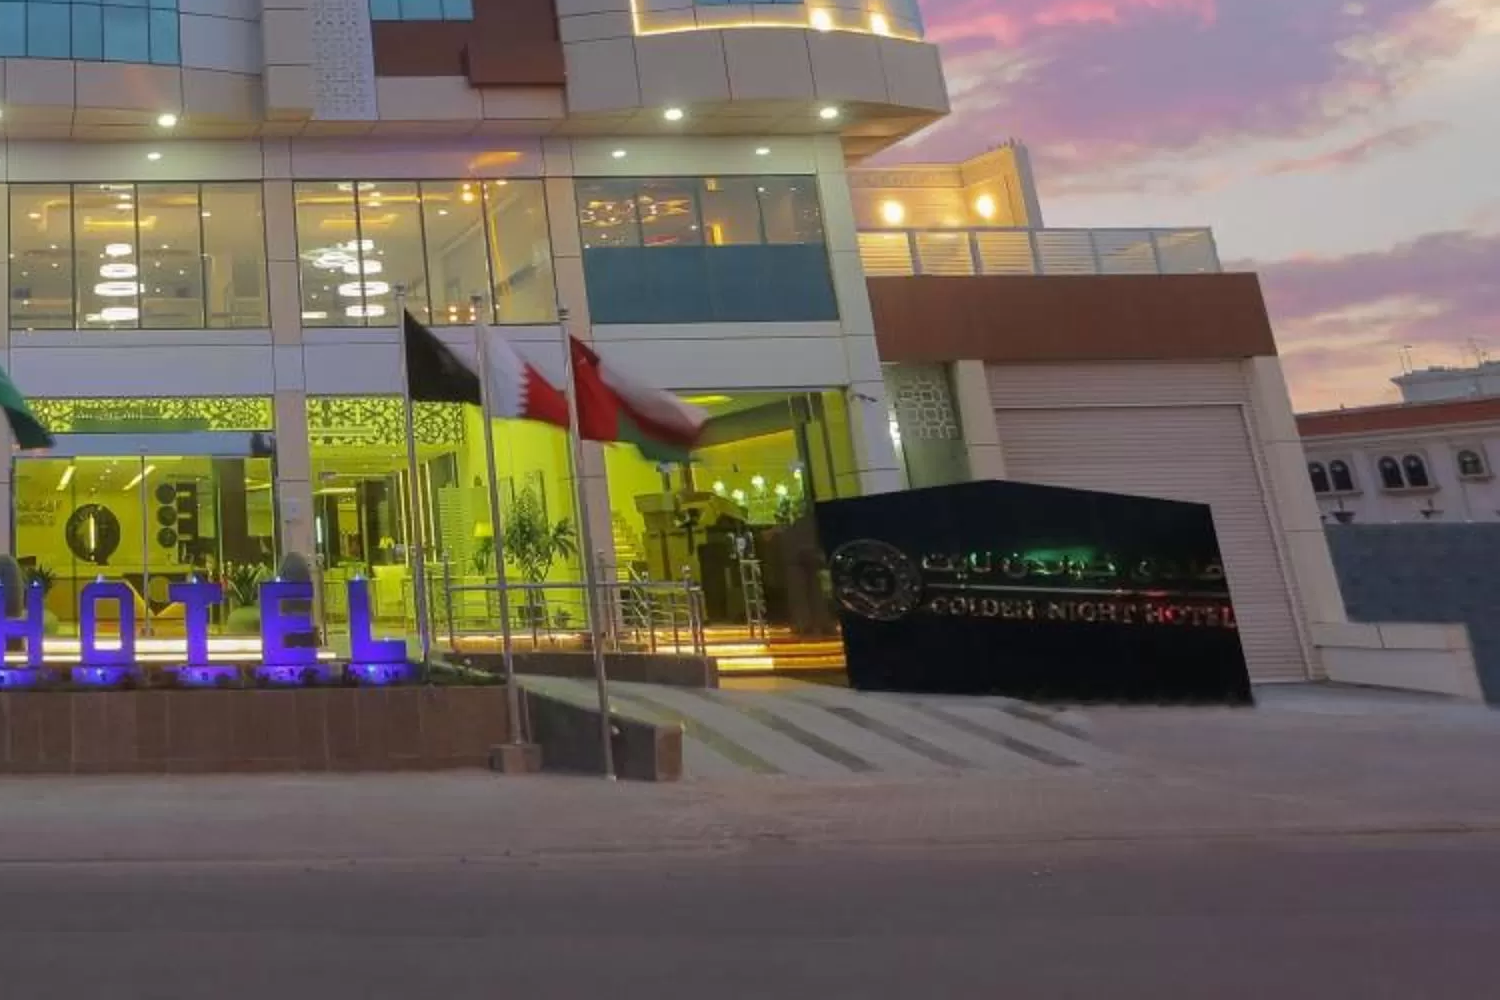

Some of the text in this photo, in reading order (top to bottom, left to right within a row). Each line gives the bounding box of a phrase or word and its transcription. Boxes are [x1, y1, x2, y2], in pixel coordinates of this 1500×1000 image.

[921, 551, 992, 580] نايت
[930, 596, 1238, 630] GOLDEN NIGHT HOTEL
